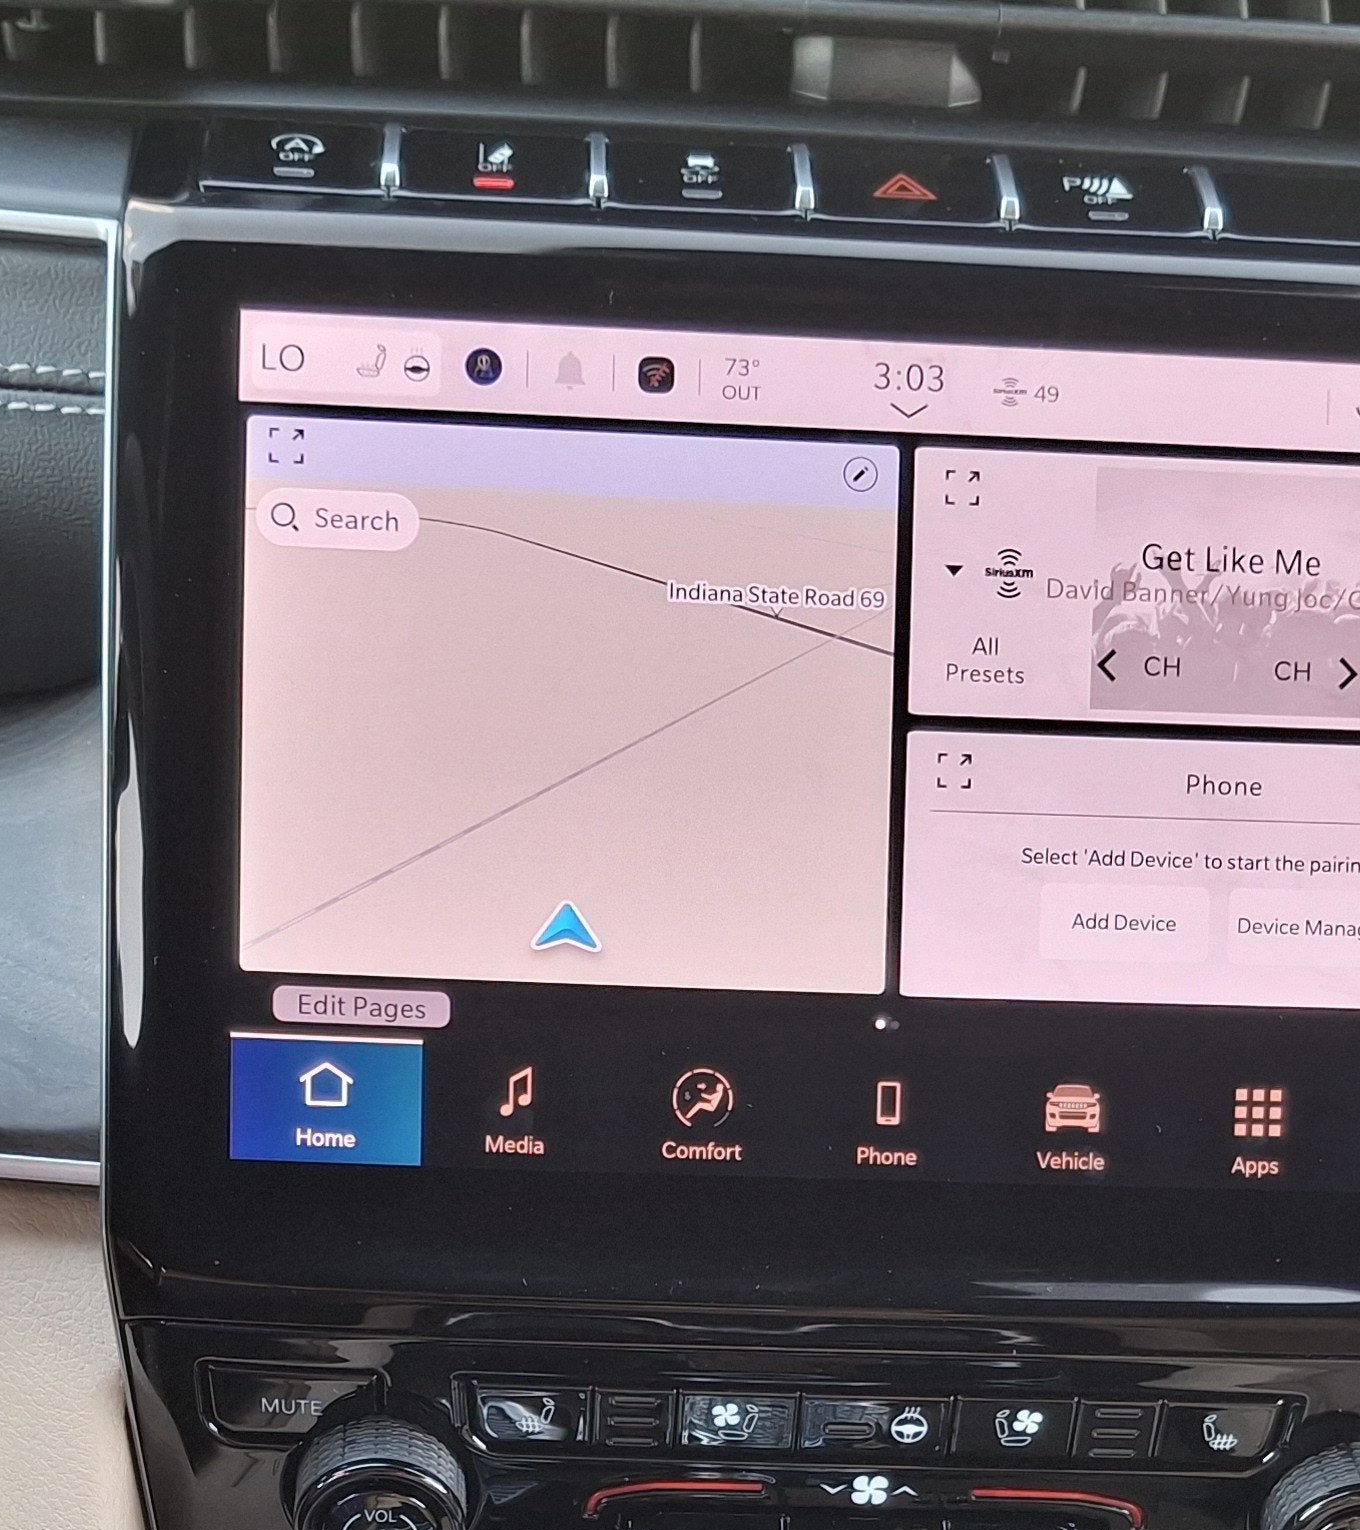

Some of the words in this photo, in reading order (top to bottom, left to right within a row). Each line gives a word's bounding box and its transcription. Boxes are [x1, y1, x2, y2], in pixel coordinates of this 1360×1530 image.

[261, 343, 305, 373] LO
[874, 362, 945, 394] 3:03
[722, 385, 762, 401] OUT
[1034, 386, 1059, 403] 49
[314, 507, 400, 533] Search
[1142, 544, 1196, 574] Get
[1206, 547, 1263, 576] Like
[1276, 550, 1322, 577] Me
[668, 581, 743, 603] Indiana
[747, 586, 799, 607] State
[805, 587, 855, 608] Road
[859, 588, 885, 609] 69
[1047, 578, 1114, 602] David
[1123, 581, 1288, 614] Banner/Yung
[972, 636, 999, 657] All
[946, 664, 1025, 685] Presets
[1144, 657, 1181, 678] CH
[1274, 661, 1312, 682] CH
[1186, 773, 1262, 798] Phone
[1022, 847, 1078, 867] Select
[1083, 848, 1125, 869] 'Add
[1130, 850, 1198, 870] Device'
[1204, 855, 1222, 871] to
[1227, 854, 1269, 873] start
[1275, 854, 1304, 874] the
[1071, 913, 1109, 931] Add
[1114, 914, 1176, 932] Device
[1237, 917, 1299, 936] Device
[297, 994, 345, 1016] Edit
[353, 997, 425, 1021] Pages
[296, 1129, 355, 1148] Home
[485, 1135, 544, 1155] Media
[662, 1141, 742, 1161] Comfort
[856, 1147, 917, 1166] Phone
[1037, 1152, 1105, 1171] Vehicle
[1231, 1157, 1279, 1177] Apps
[261, 1397, 323, 1416] MUTE
[365, 1510, 397, 1523] VOL
